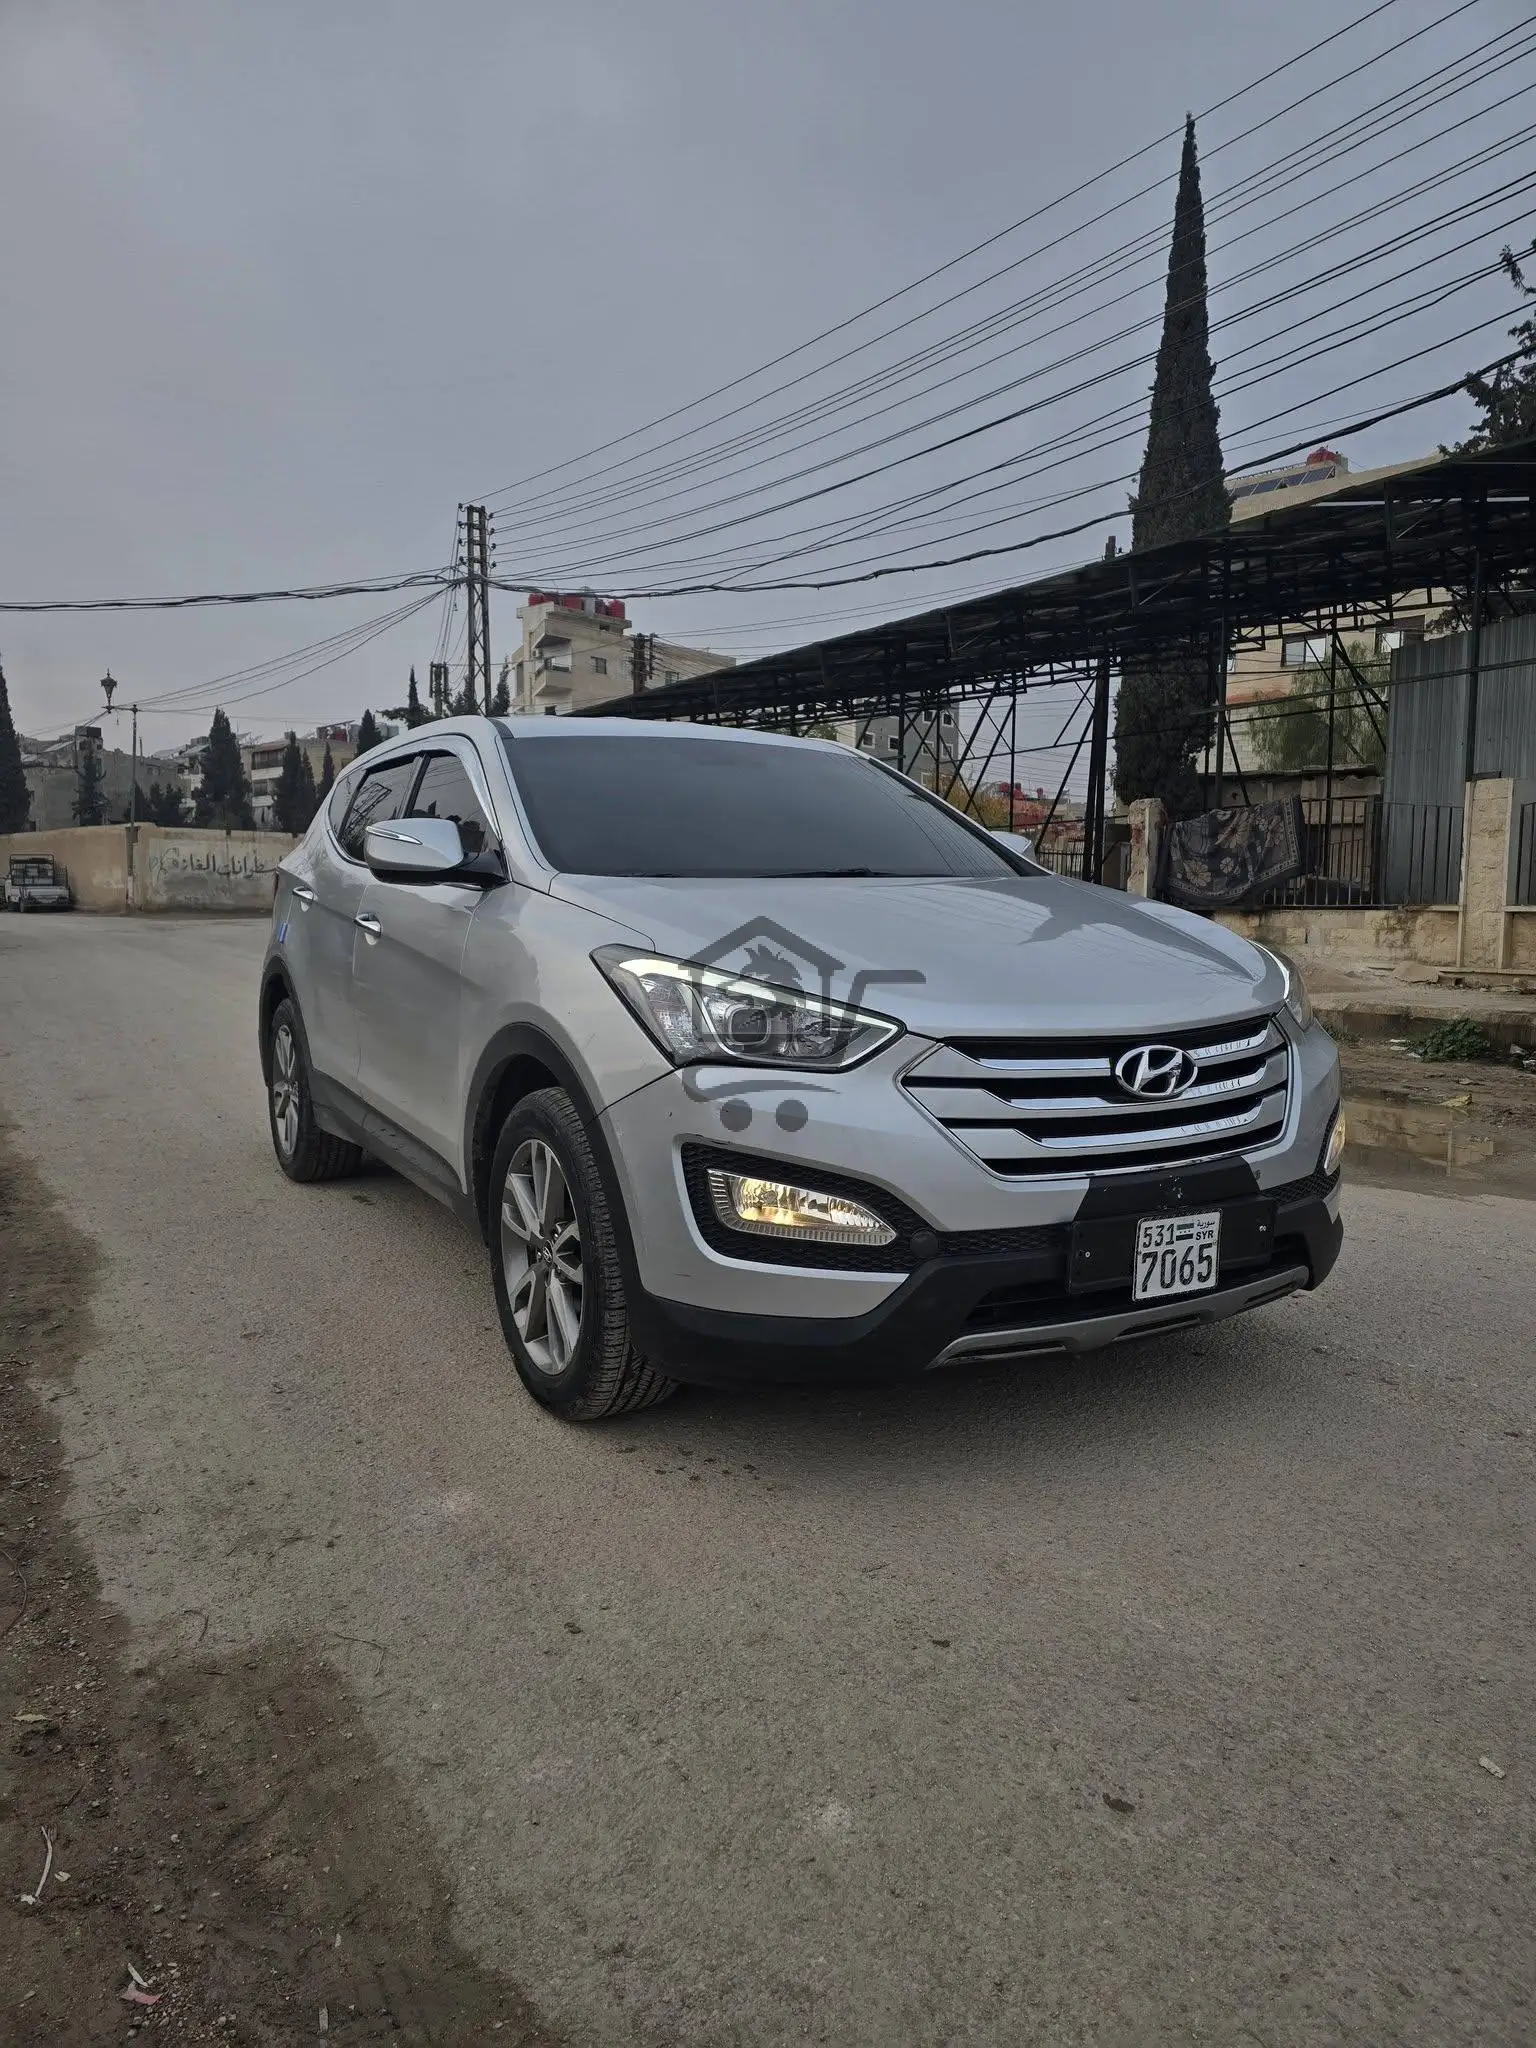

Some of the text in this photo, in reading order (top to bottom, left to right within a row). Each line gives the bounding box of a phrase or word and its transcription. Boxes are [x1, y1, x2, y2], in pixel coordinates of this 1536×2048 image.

[1142, 1223, 1175, 1249] 531
[1195, 1230, 1214, 1241] SYR
[1141, 1243, 1213, 1293] 7065
